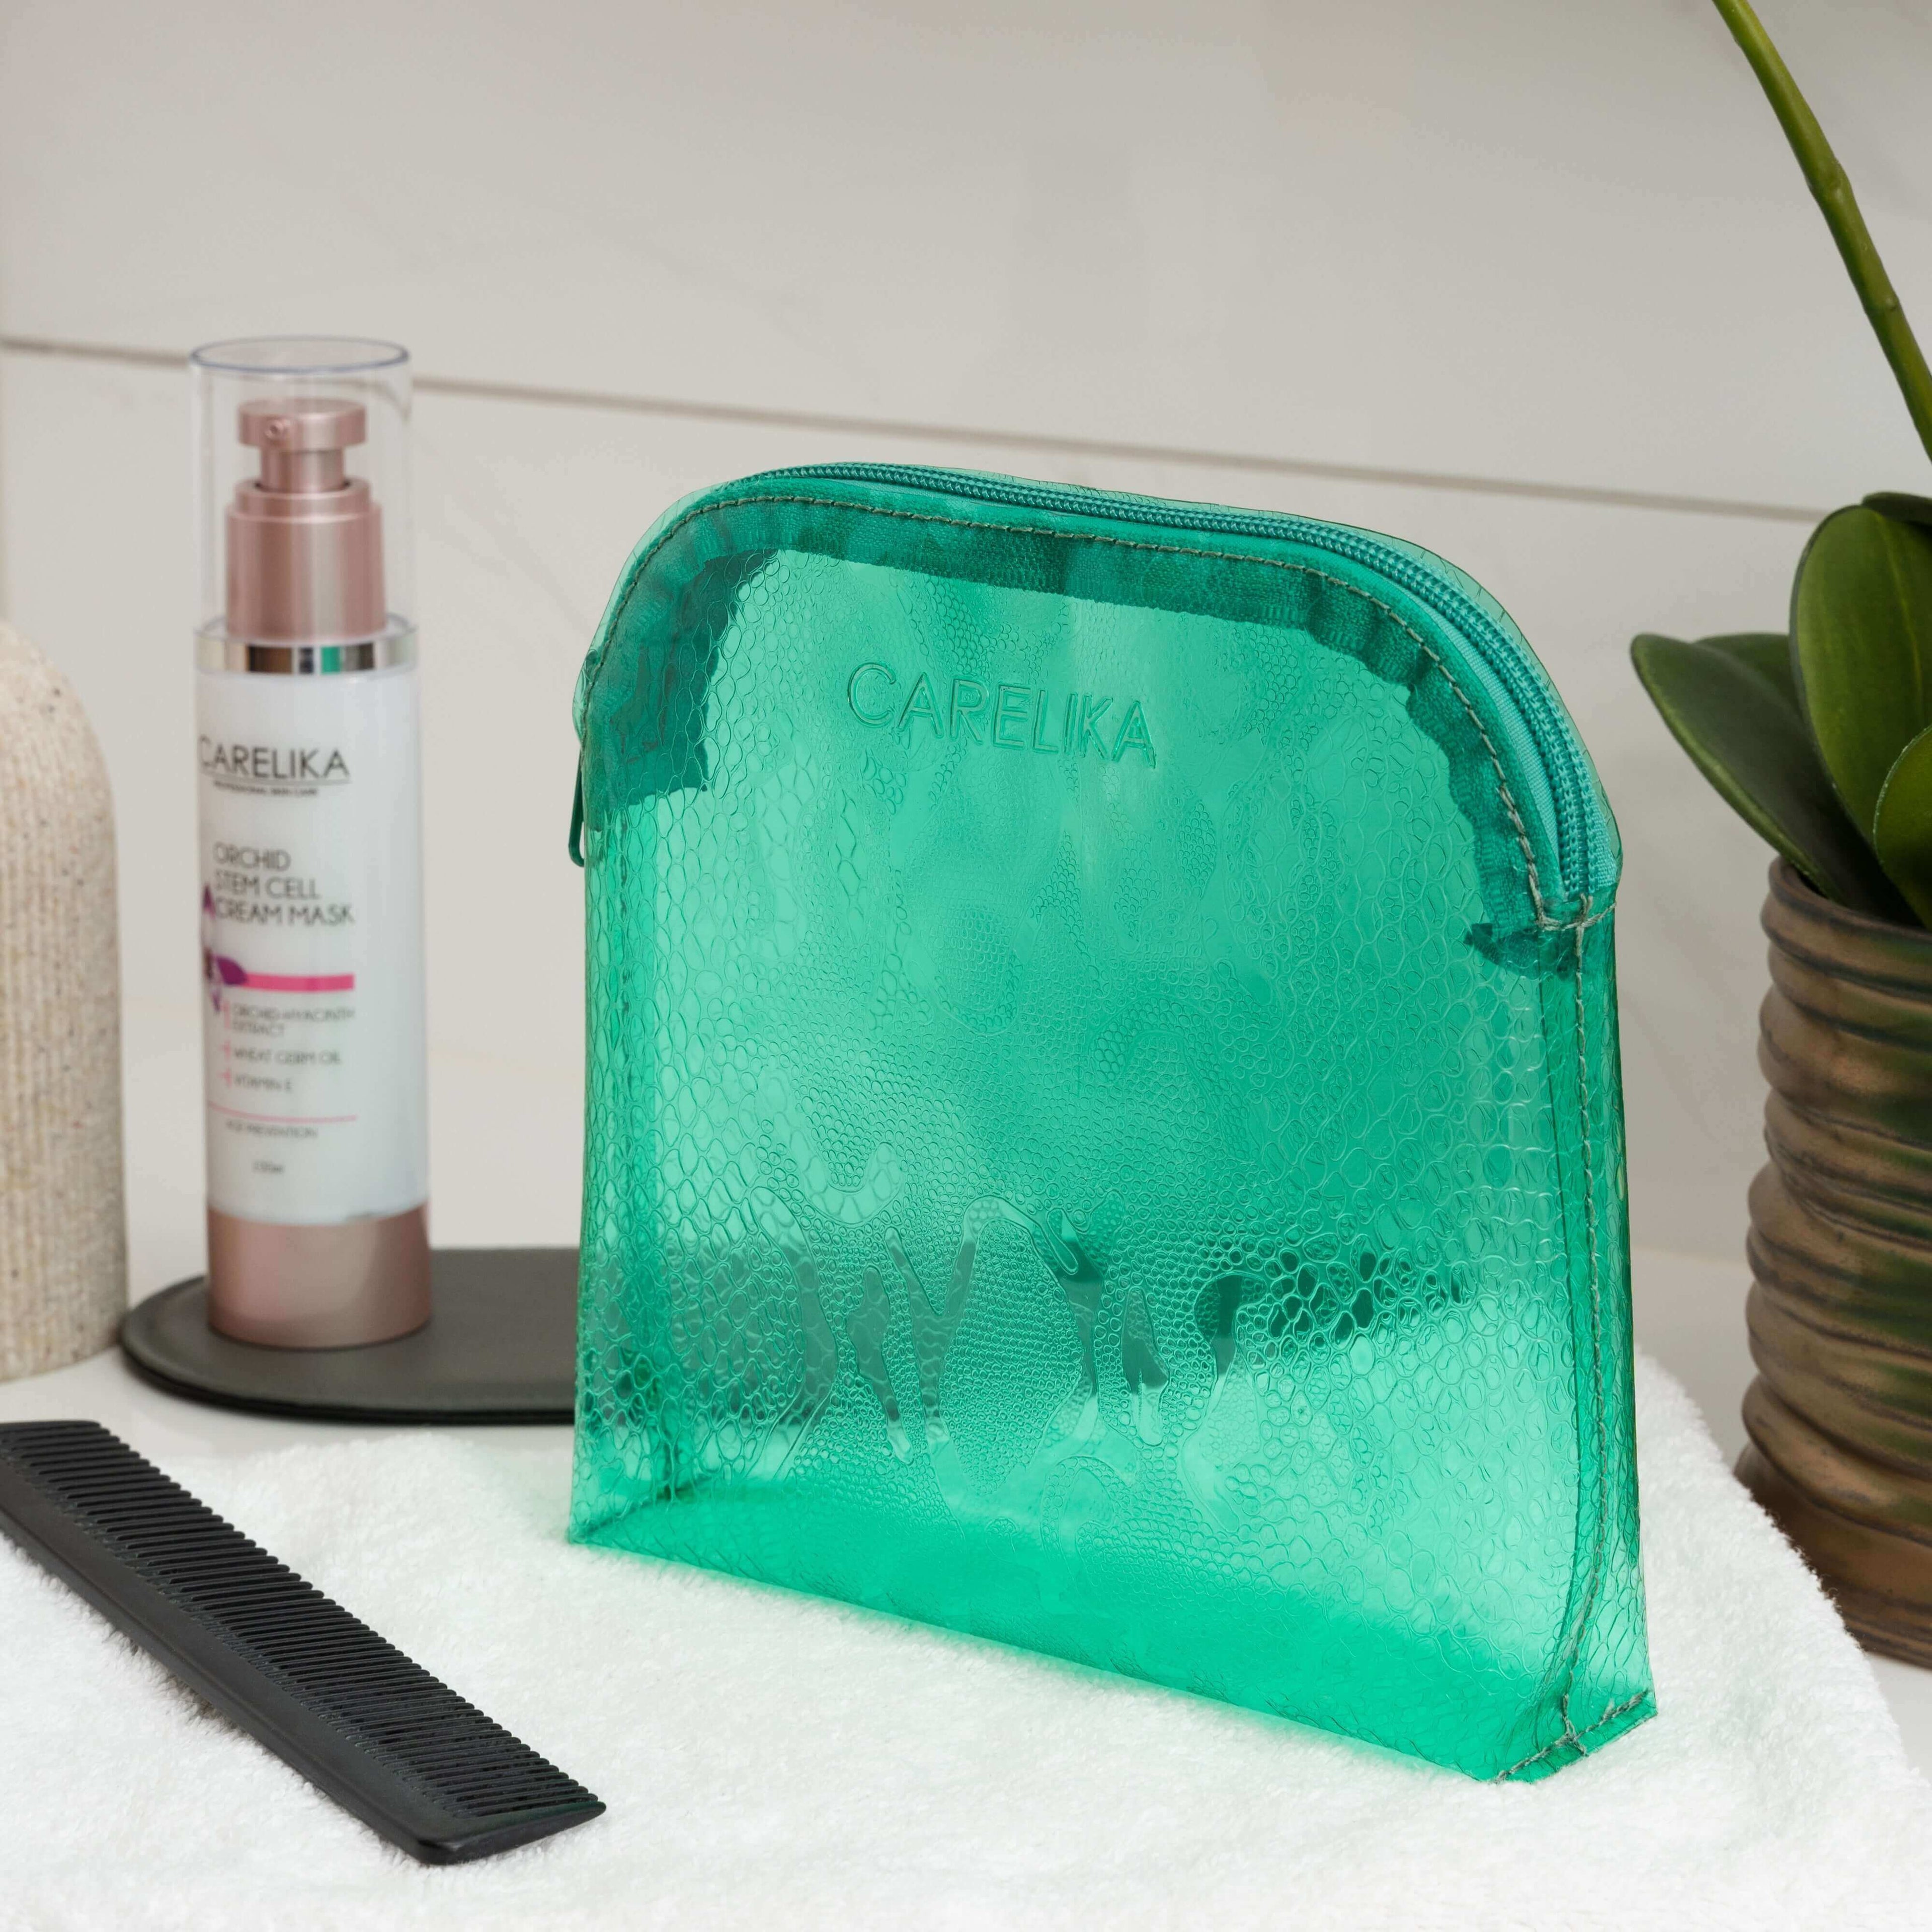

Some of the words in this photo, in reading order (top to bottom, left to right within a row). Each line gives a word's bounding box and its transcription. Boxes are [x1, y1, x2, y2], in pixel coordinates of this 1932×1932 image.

[848, 661, 1156, 768] CARELIKA
[198, 735, 350, 779] CARELIKA
[213, 842, 291, 871] ORCHID
[215, 868, 261, 897] STEM
[265, 876, 322, 900] CELL
[214, 897, 283, 925] CREAM
[288, 904, 355, 926] MASK
